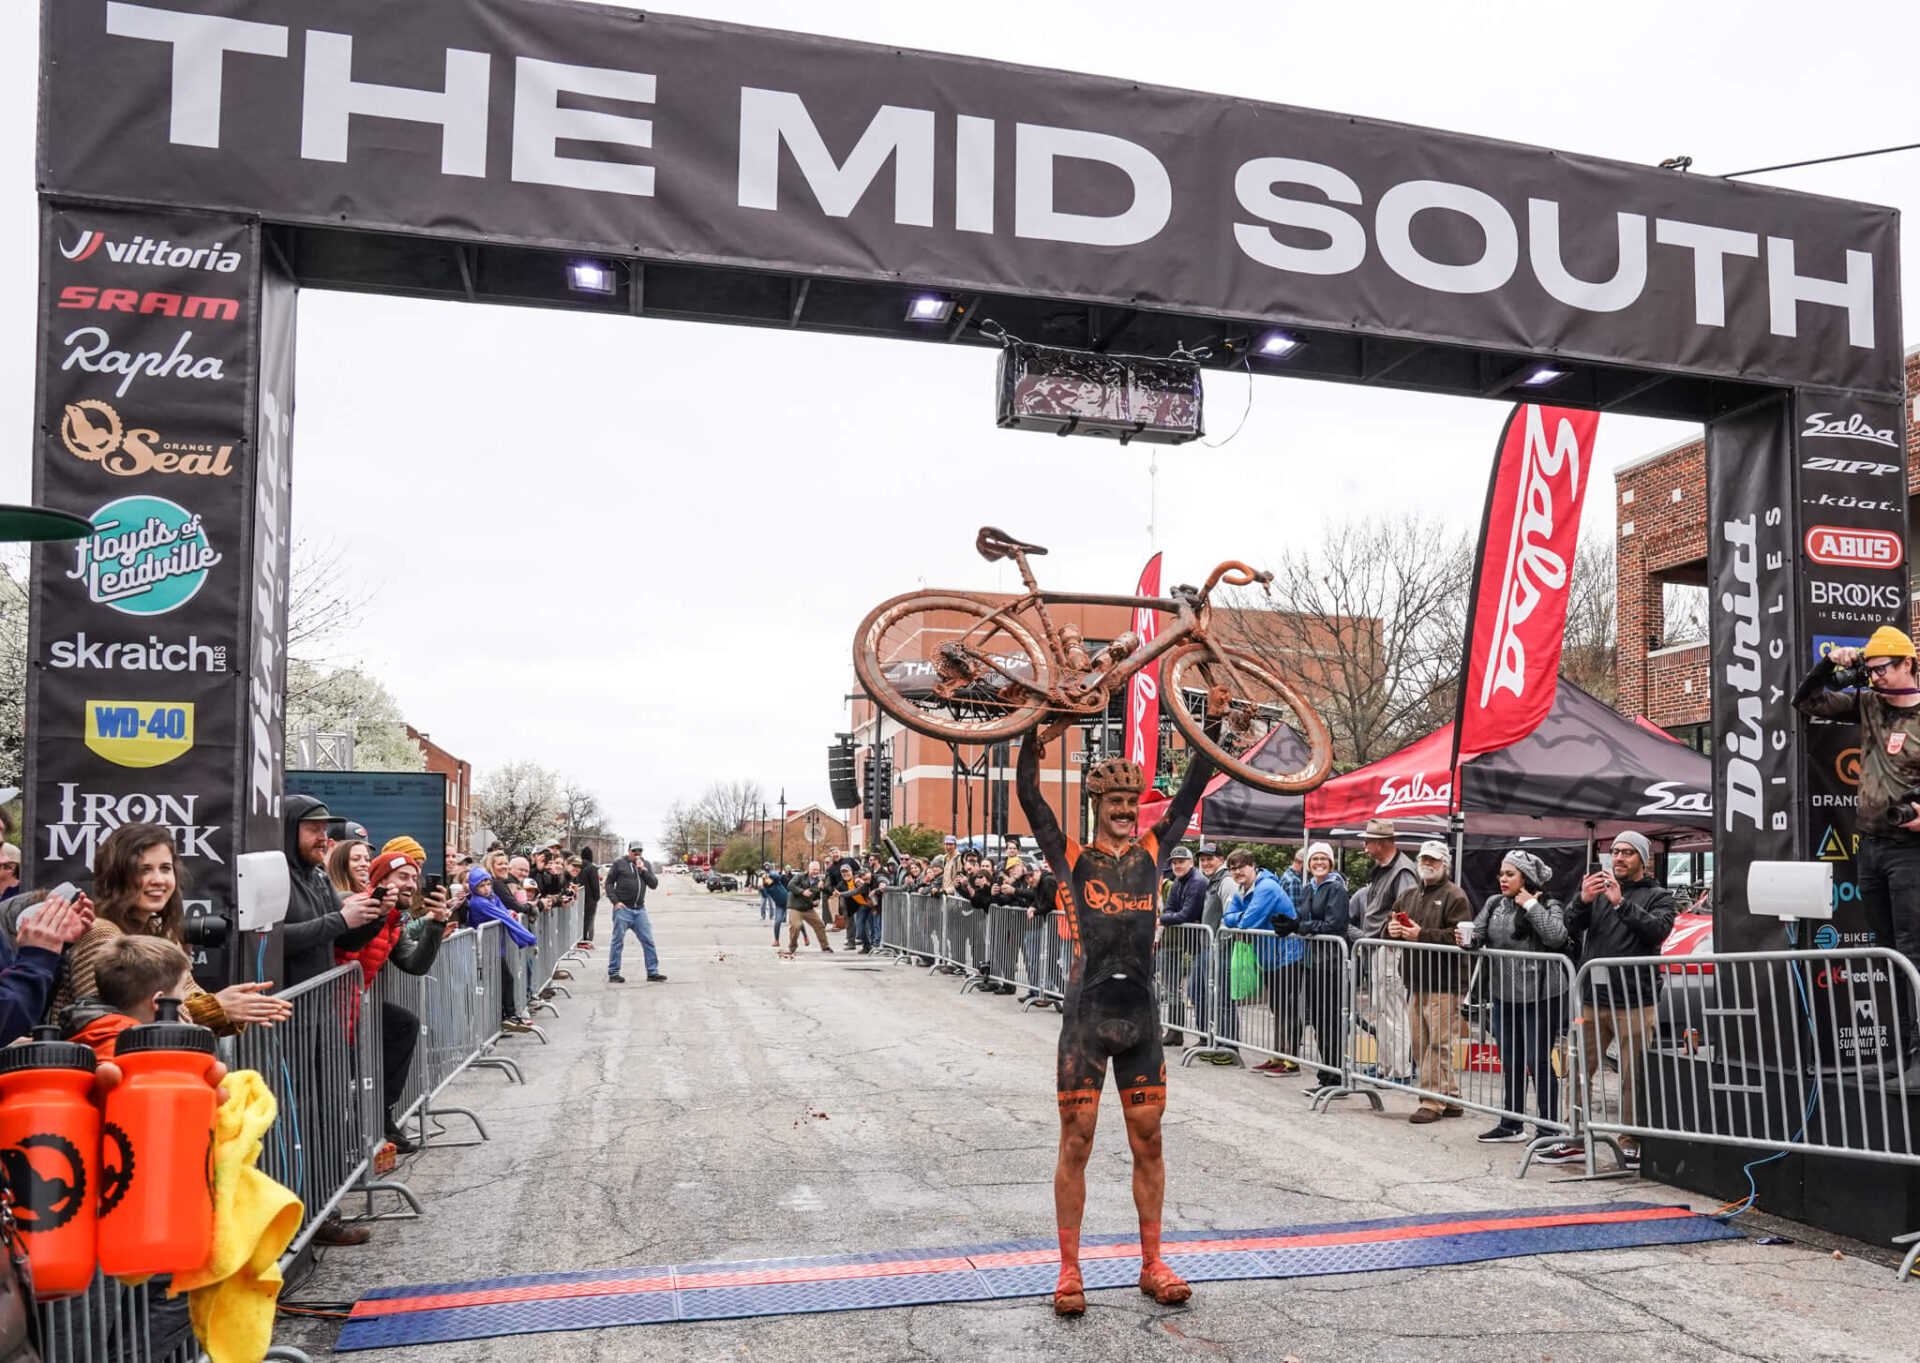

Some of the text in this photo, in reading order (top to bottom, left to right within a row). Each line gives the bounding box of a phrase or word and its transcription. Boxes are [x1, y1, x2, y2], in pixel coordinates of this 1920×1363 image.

[106, 1, 1875, 349] THE MID SOUTH
[105, 236, 242, 273] vittoria
[58, 286, 240, 321] SRAM
[61, 326, 224, 398] Rapha
[163, 443, 213, 452] ORANGE
[1802, 412, 1899, 448] Salsa
[102, 429, 233, 476] Seal
[1802, 457, 1900, 476] ZIPP
[66, 514, 202, 579] Floyd's of
[1481, 403, 1579, 709] Salsa
[1820, 535, 1891, 560] ABUS
[90, 542, 222, 602] Leadville
[1811, 580, 1900, 608] BROOKS
[1832, 611, 1882, 622] ENGLAND
[50, 632, 214, 671] skratch
[214, 645, 226, 672] LABS
[1765, 507, 1788, 831] BICYCLES
[1722, 513, 1764, 832] District
[95, 706, 186, 739] WD-40
[57, 782, 199, 829] IRON
[1375, 771, 1457, 815] Salsa
